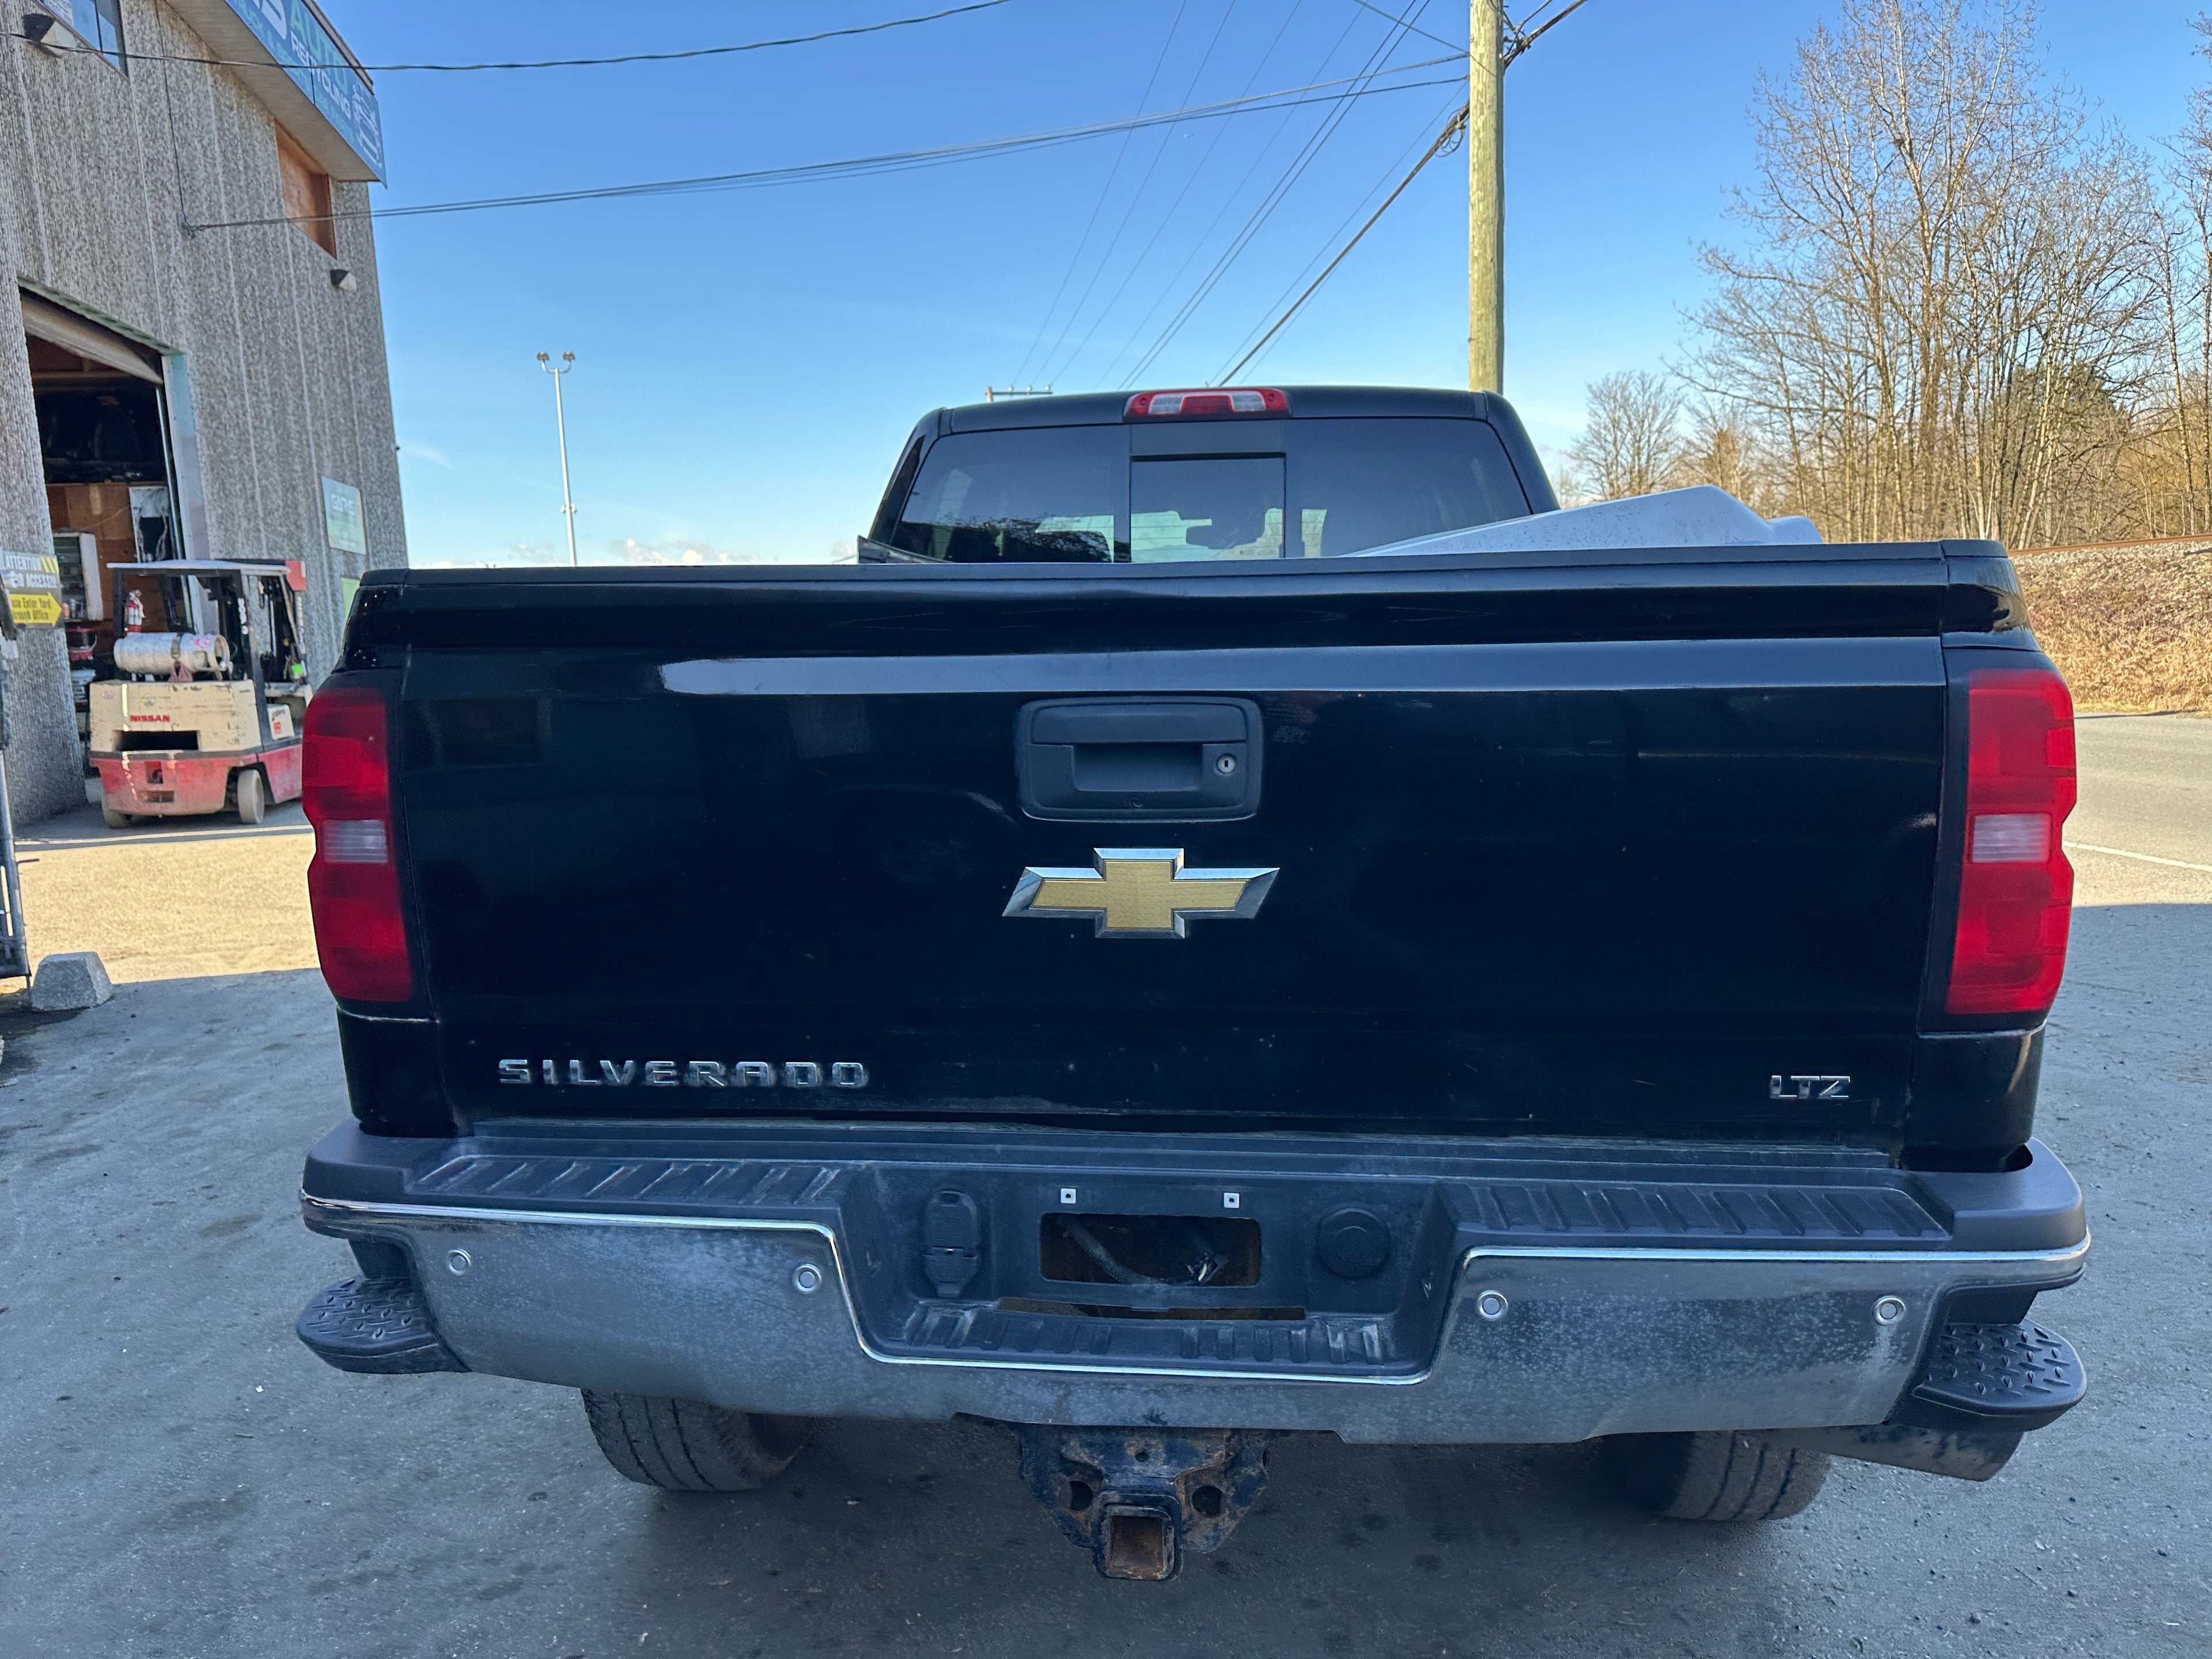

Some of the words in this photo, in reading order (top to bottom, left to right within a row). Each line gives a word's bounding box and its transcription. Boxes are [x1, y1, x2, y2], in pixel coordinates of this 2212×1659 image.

[234, 0, 264, 38] RUCK
[290, 0, 349, 96] AUTO
[290, 29, 351, 120] RECYCLING
[498, 1058, 869, 1087] SILVERADO
[1768, 1075, 1851, 1099] LTZ
